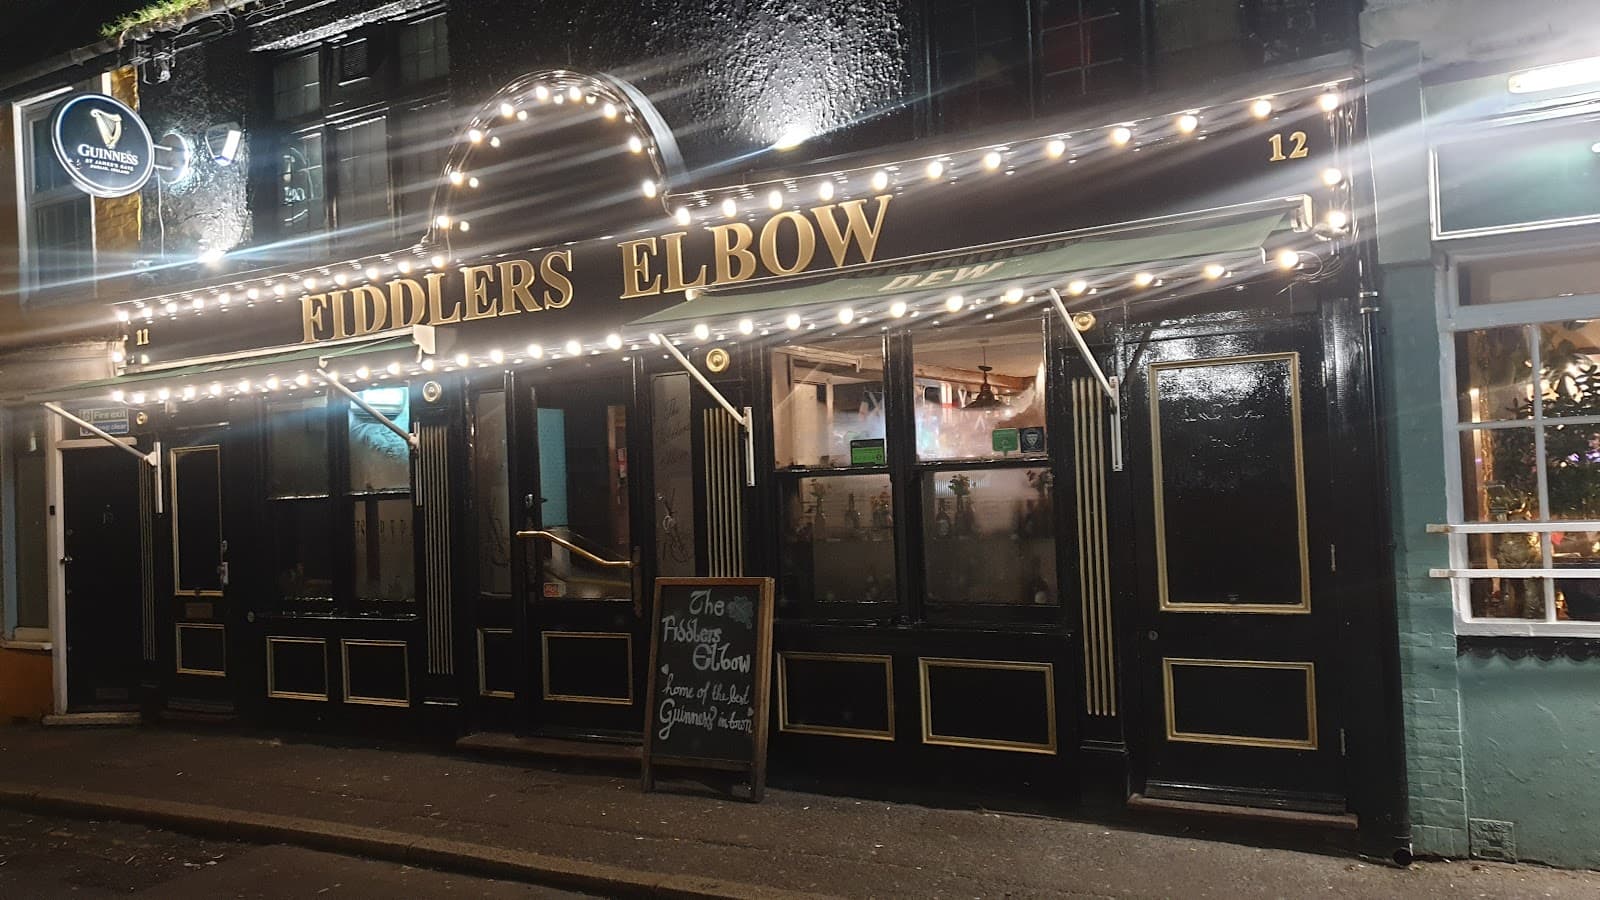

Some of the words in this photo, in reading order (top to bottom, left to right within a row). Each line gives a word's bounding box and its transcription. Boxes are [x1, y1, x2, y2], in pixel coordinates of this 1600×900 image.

[77, 143, 139, 166] GUINNESS
[1268, 131, 1309, 162] 12
[299, 250, 574, 343] FIDDLERS
[617, 195, 893, 299] ELBOW
[878, 261, 1006, 292] DEW
[136, 328, 149, 346] 11
[689, 589, 725, 616] The
[661, 615, 723, 643] Fiddlers
[692, 642, 751, 673] Elbow
[662, 673, 695, 699] home
[697, 681, 711, 705] of
[712, 683, 728, 701] the
[728, 684, 751, 706] best
[659, 698, 718, 740] Guinness
